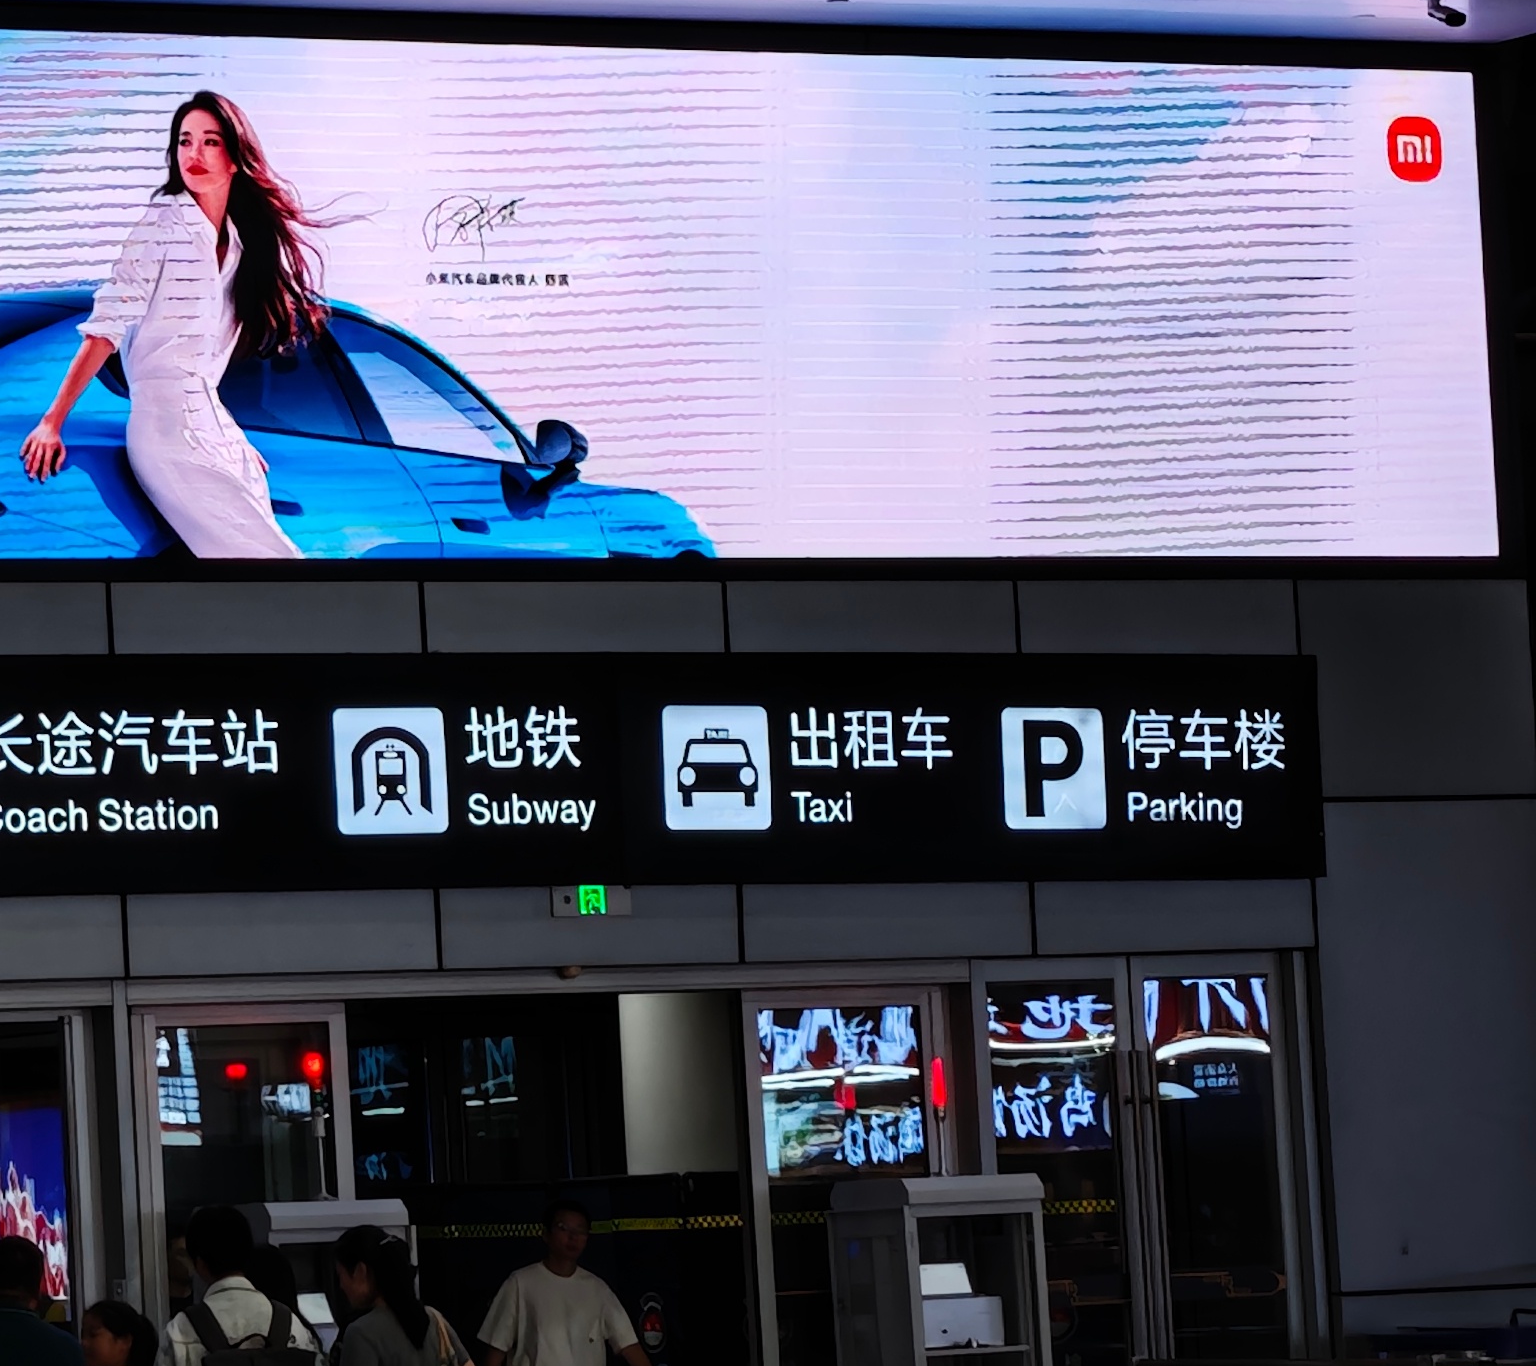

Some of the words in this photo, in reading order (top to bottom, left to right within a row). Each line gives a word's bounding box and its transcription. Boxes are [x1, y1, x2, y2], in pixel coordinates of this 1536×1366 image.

[464, 705, 582, 770] 地铁
[790, 706, 954, 771] 出租车
[1121, 708, 1286, 771] 停车楼
[98, 797, 219, 833] Station
[467, 792, 597, 832] Subway
[790, 790, 853, 823] Taxi
[1127, 791, 1243, 830] Parking
